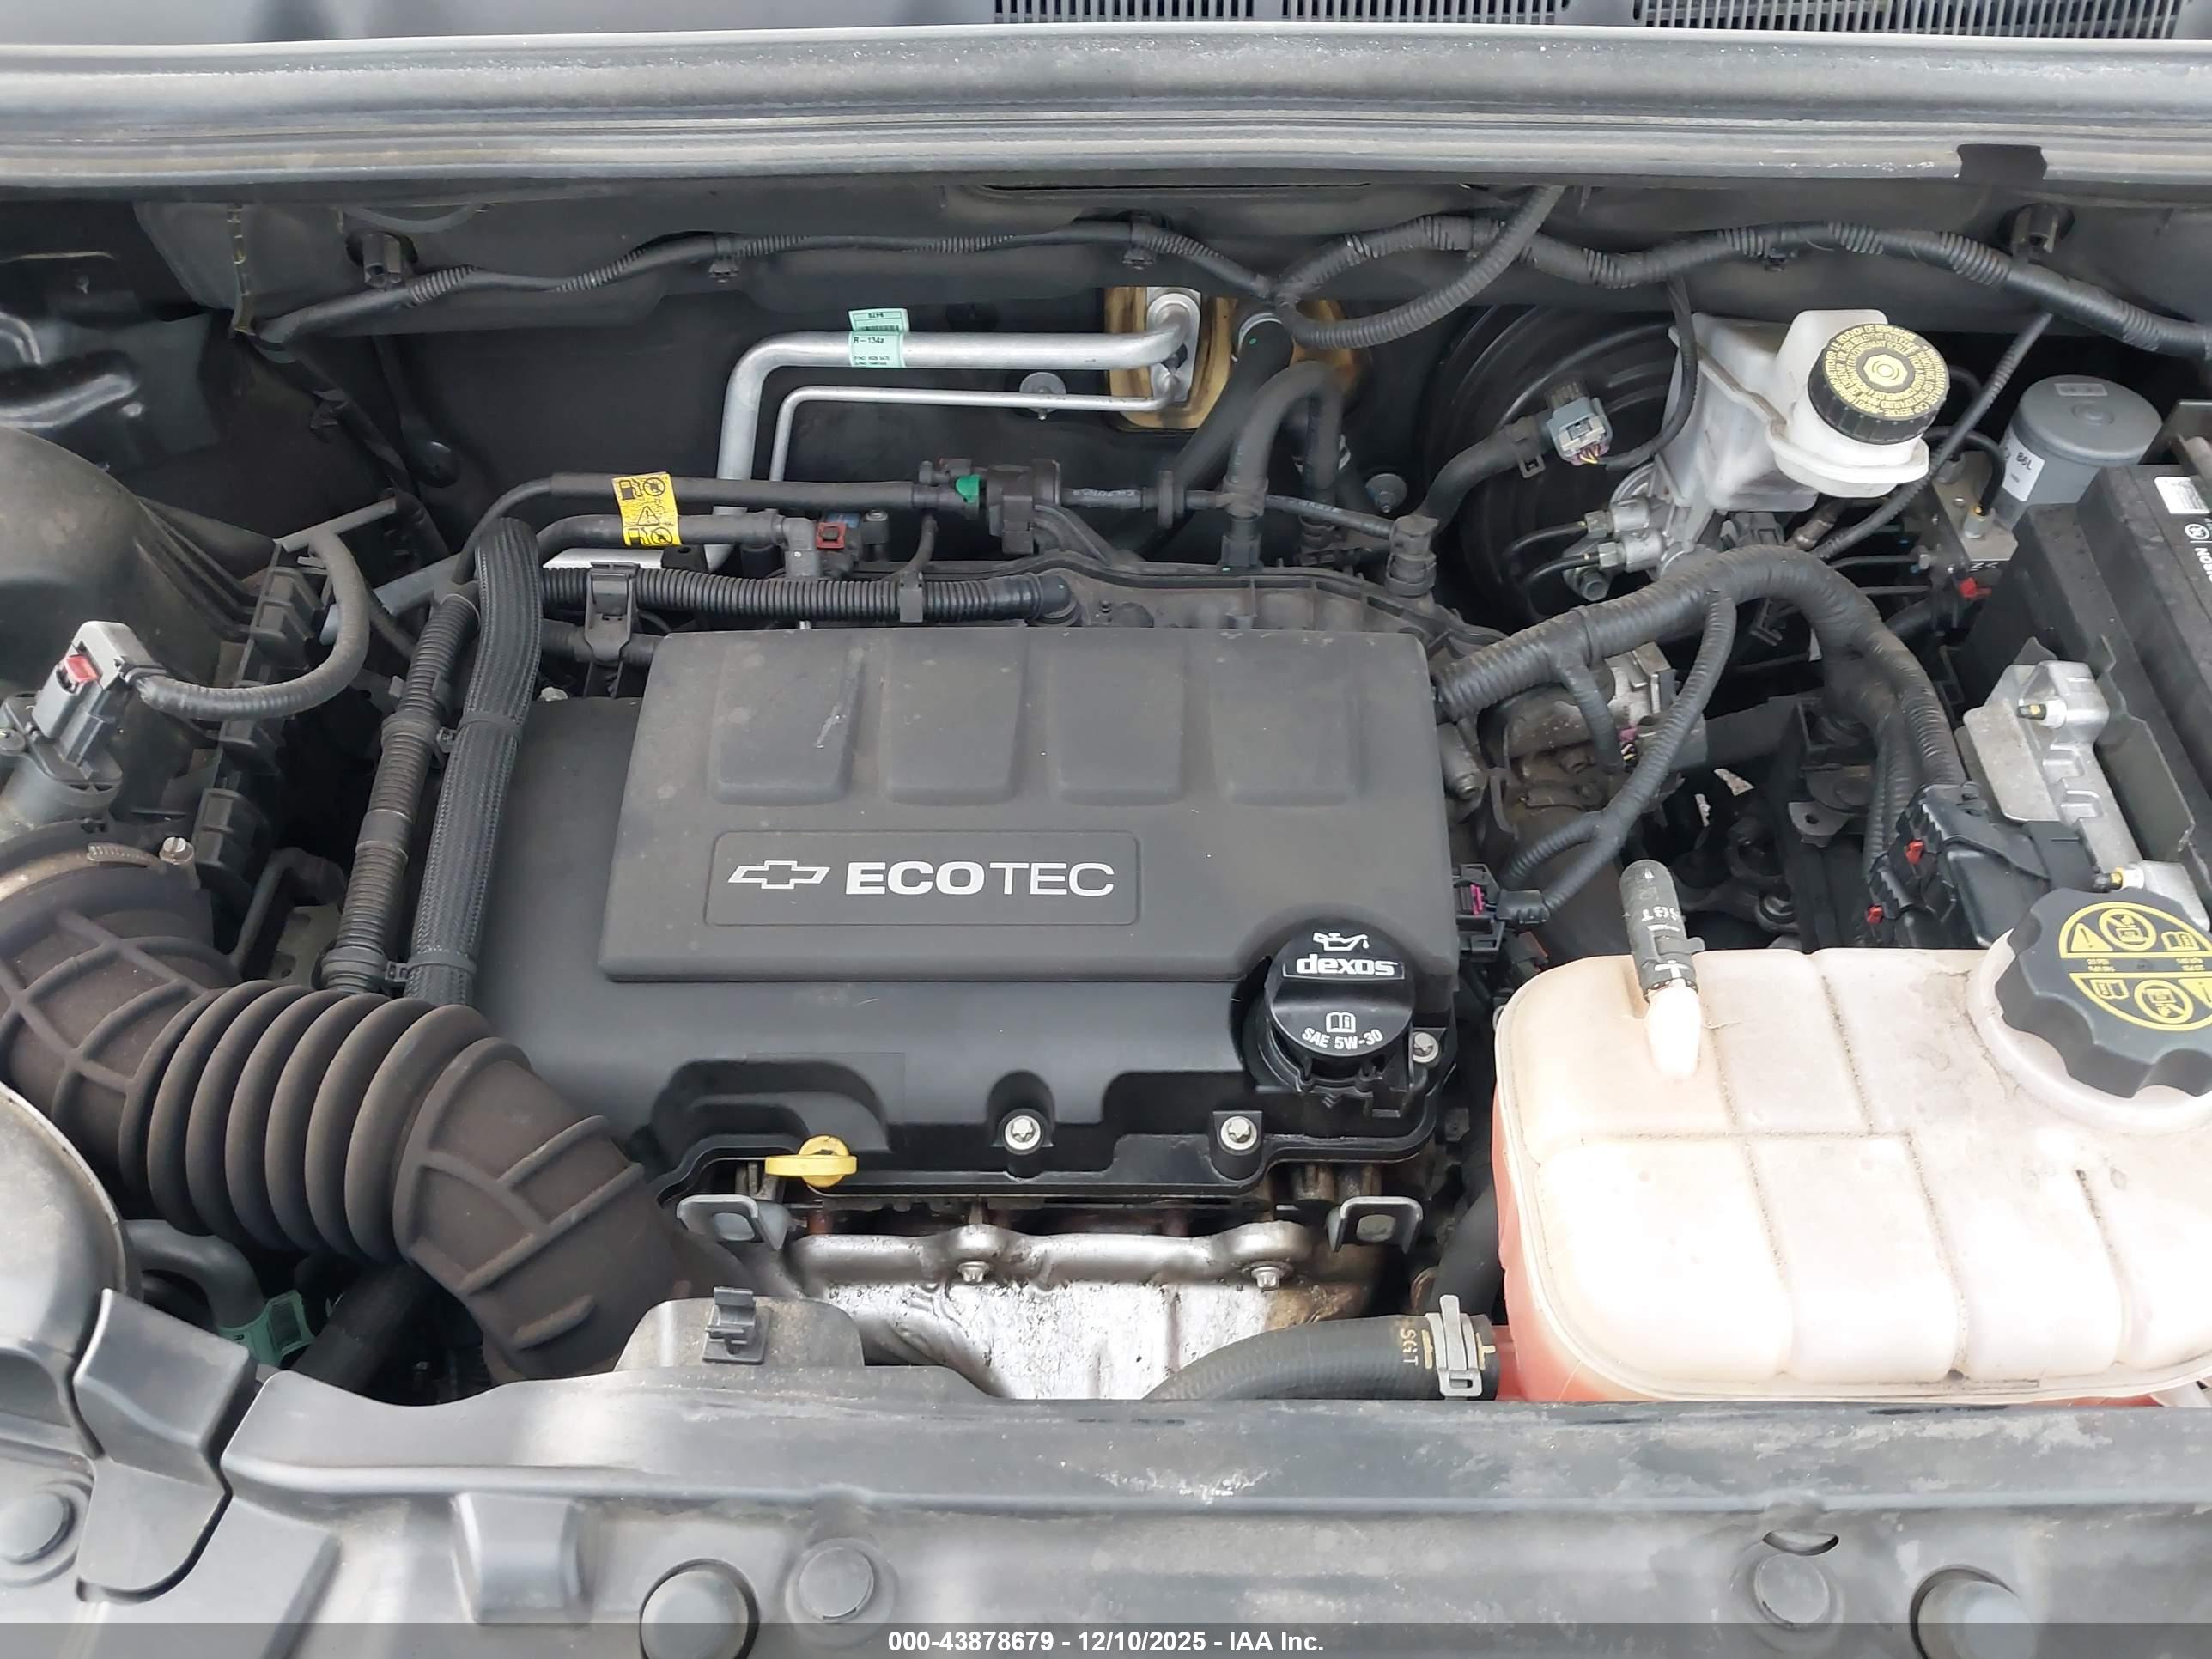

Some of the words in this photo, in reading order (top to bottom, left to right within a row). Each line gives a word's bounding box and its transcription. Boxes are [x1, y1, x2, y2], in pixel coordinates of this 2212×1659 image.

[845, 860, 1115, 896] ECOTEC
[1297, 953, 1398, 976] dexos
[1302, 1028, 1330, 1048] SAE
[1334, 1029, 1383, 1050] 5W-30
